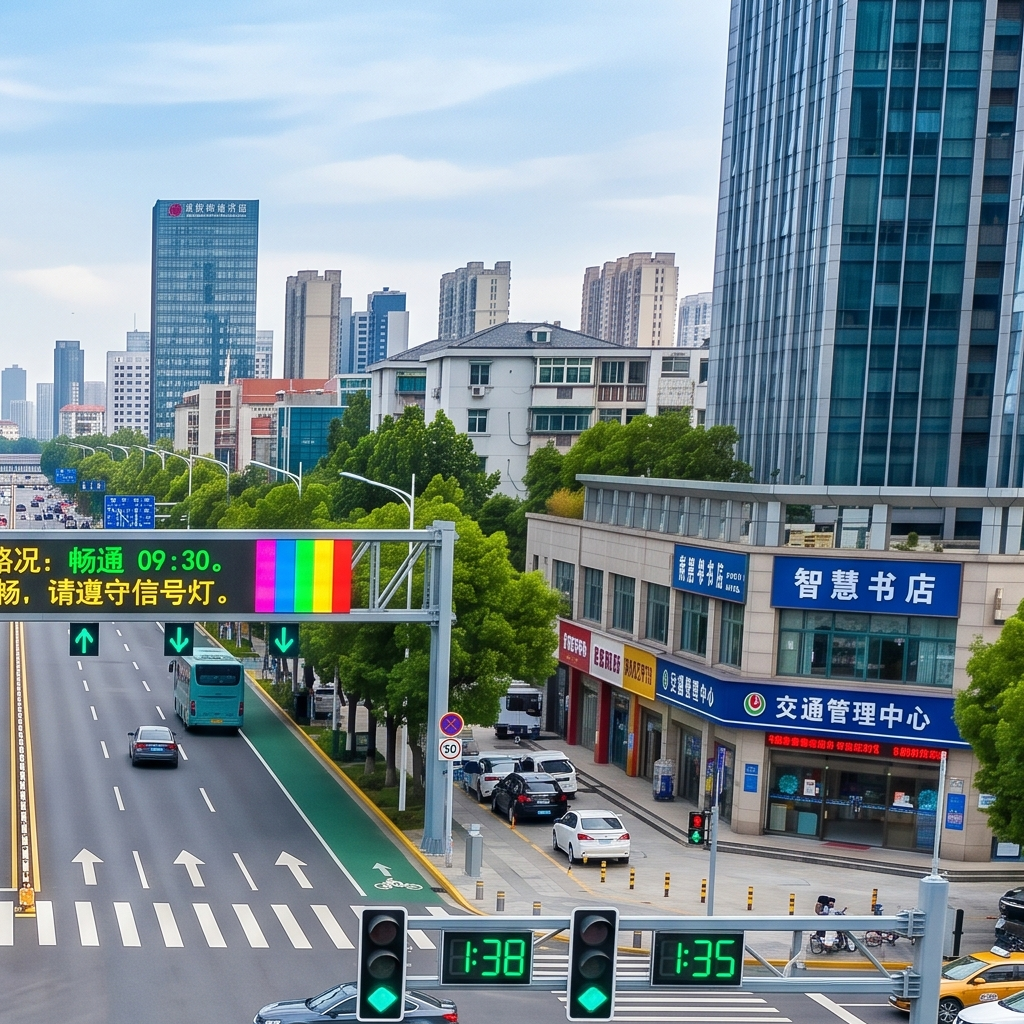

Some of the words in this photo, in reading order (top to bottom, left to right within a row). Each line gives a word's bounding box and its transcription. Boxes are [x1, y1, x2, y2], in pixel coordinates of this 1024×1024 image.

[794, 567, 936, 605] 智慧书店
[775, 694, 931, 732] 交通管理中心
[465, 938, 526, 977] 1:38
[676, 939, 735, 978] 1:35
